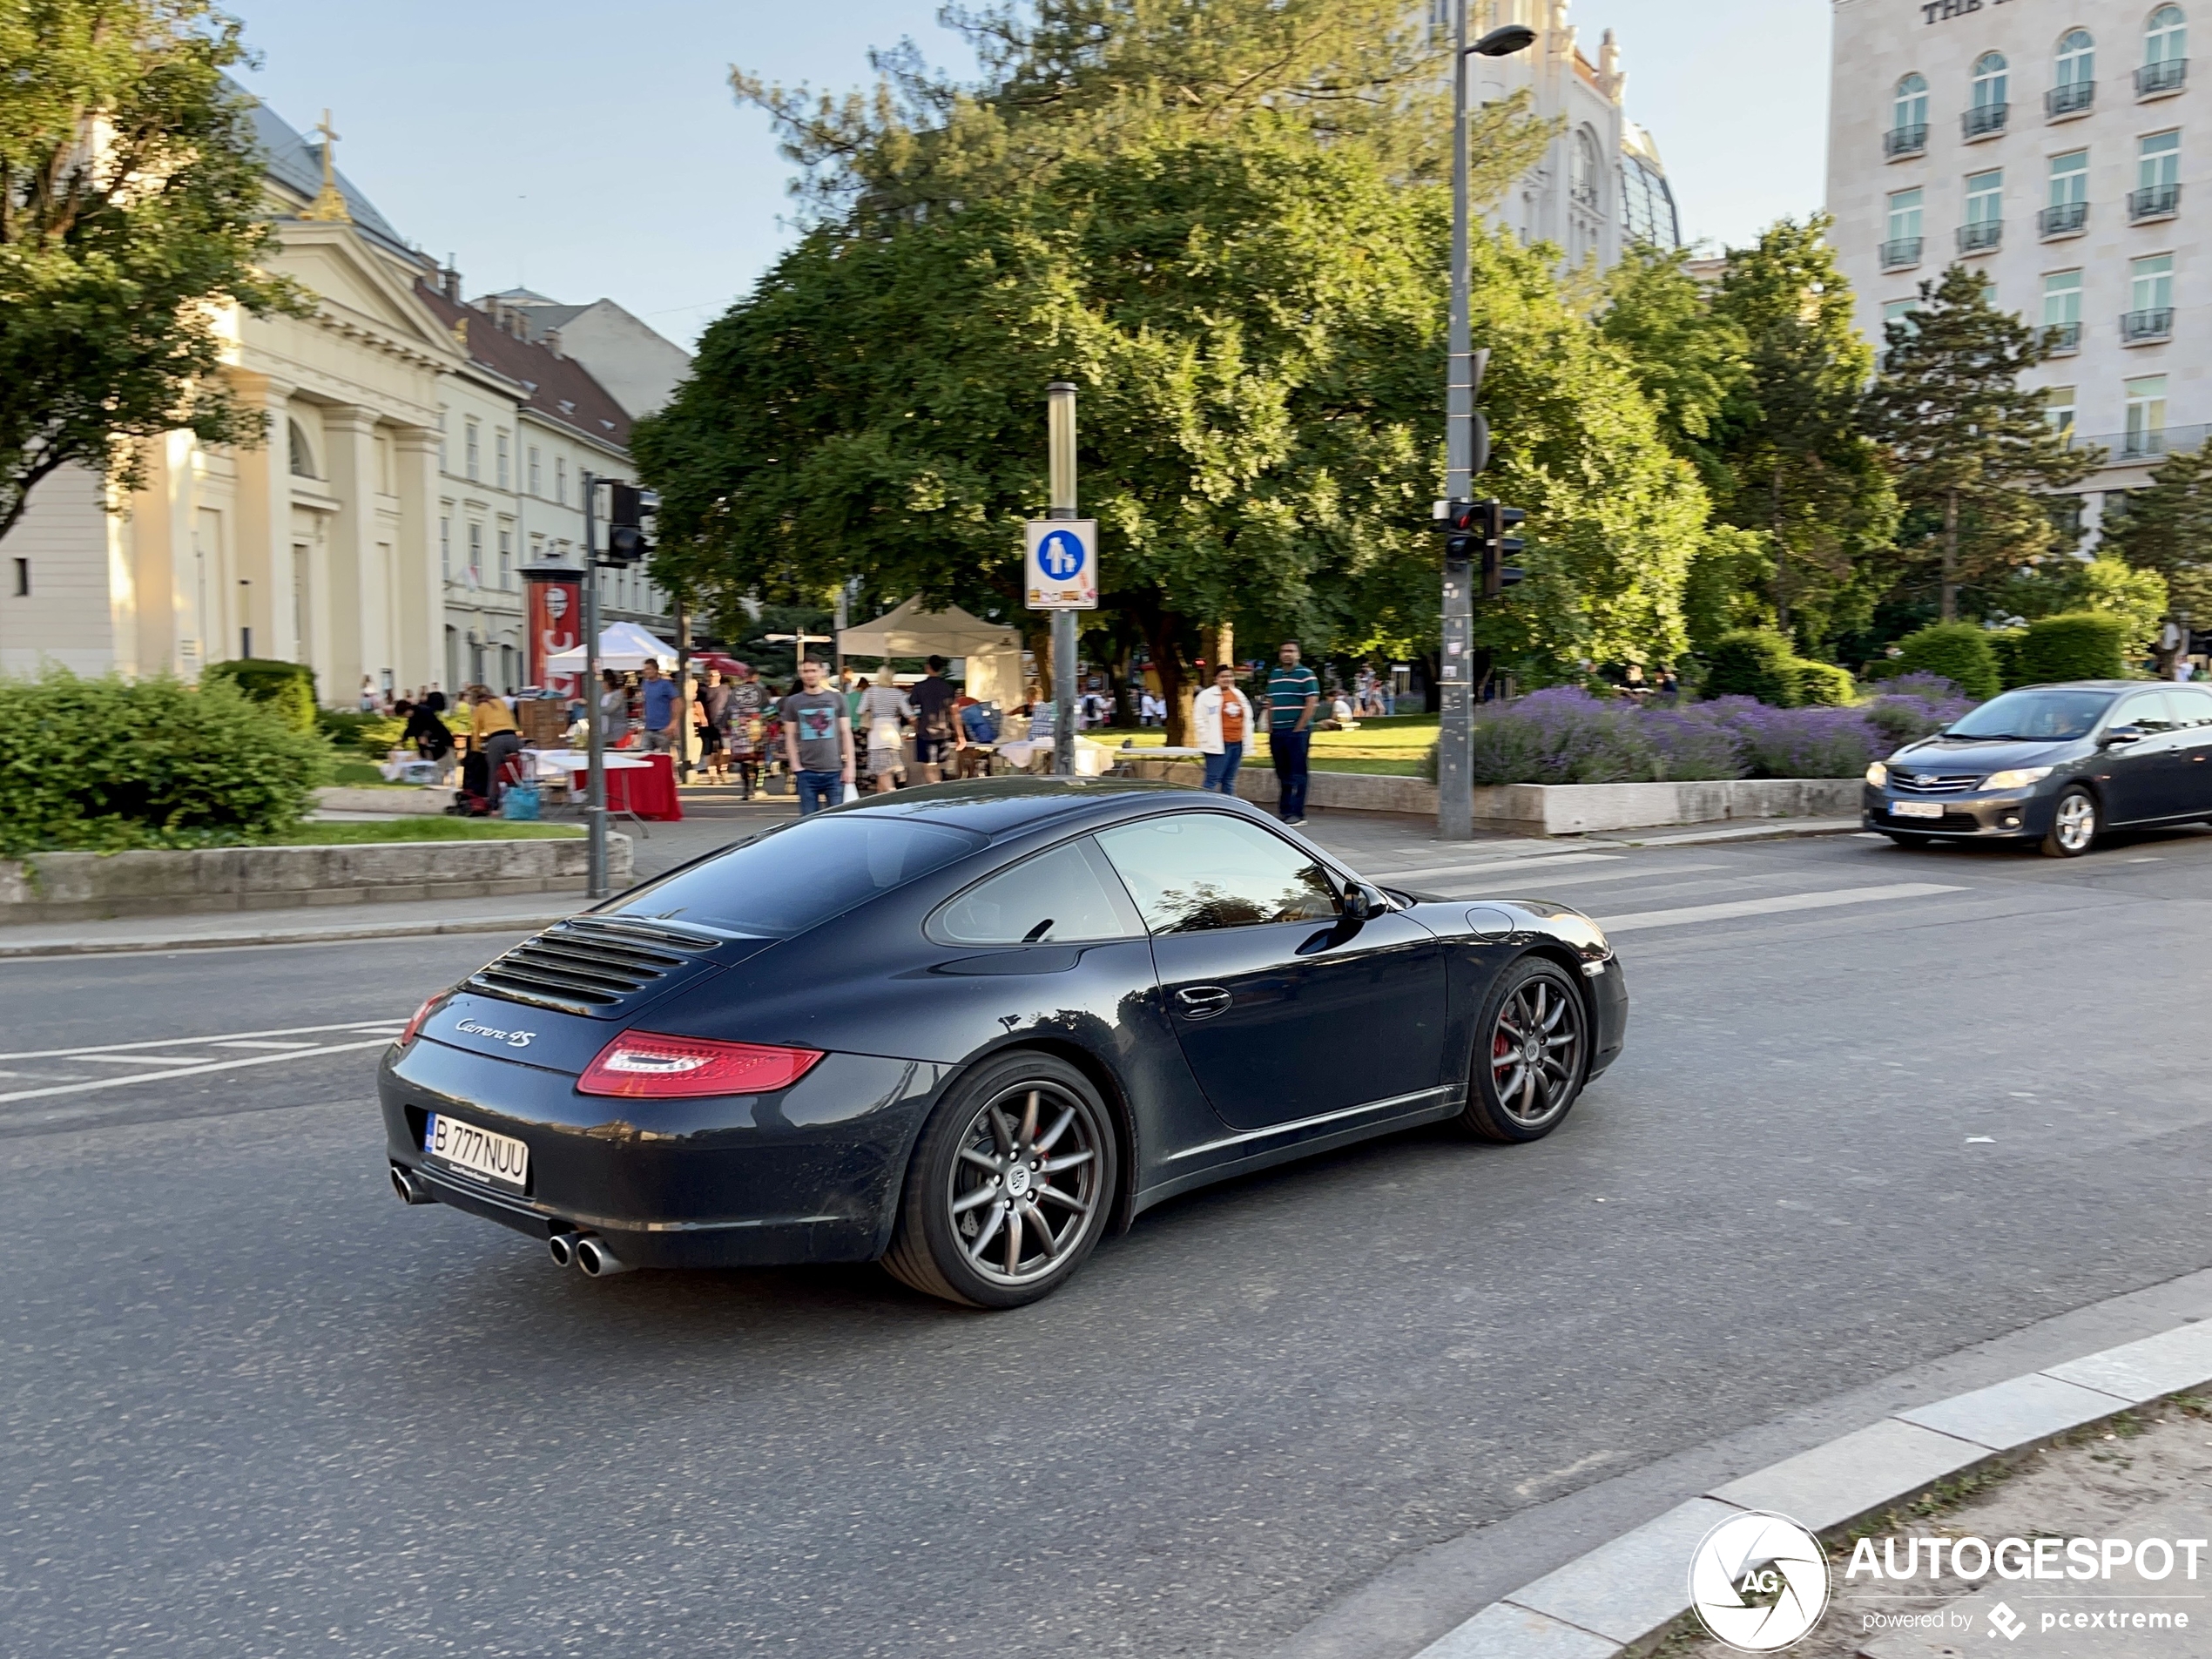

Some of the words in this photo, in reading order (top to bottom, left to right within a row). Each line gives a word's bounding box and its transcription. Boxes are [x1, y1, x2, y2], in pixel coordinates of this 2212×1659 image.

[455, 1018, 508, 1040] Carrera
[507, 1030, 536, 1047] 4S
[435, 1119, 448, 1151] B
[452, 1125, 525, 1177] 777NUU
